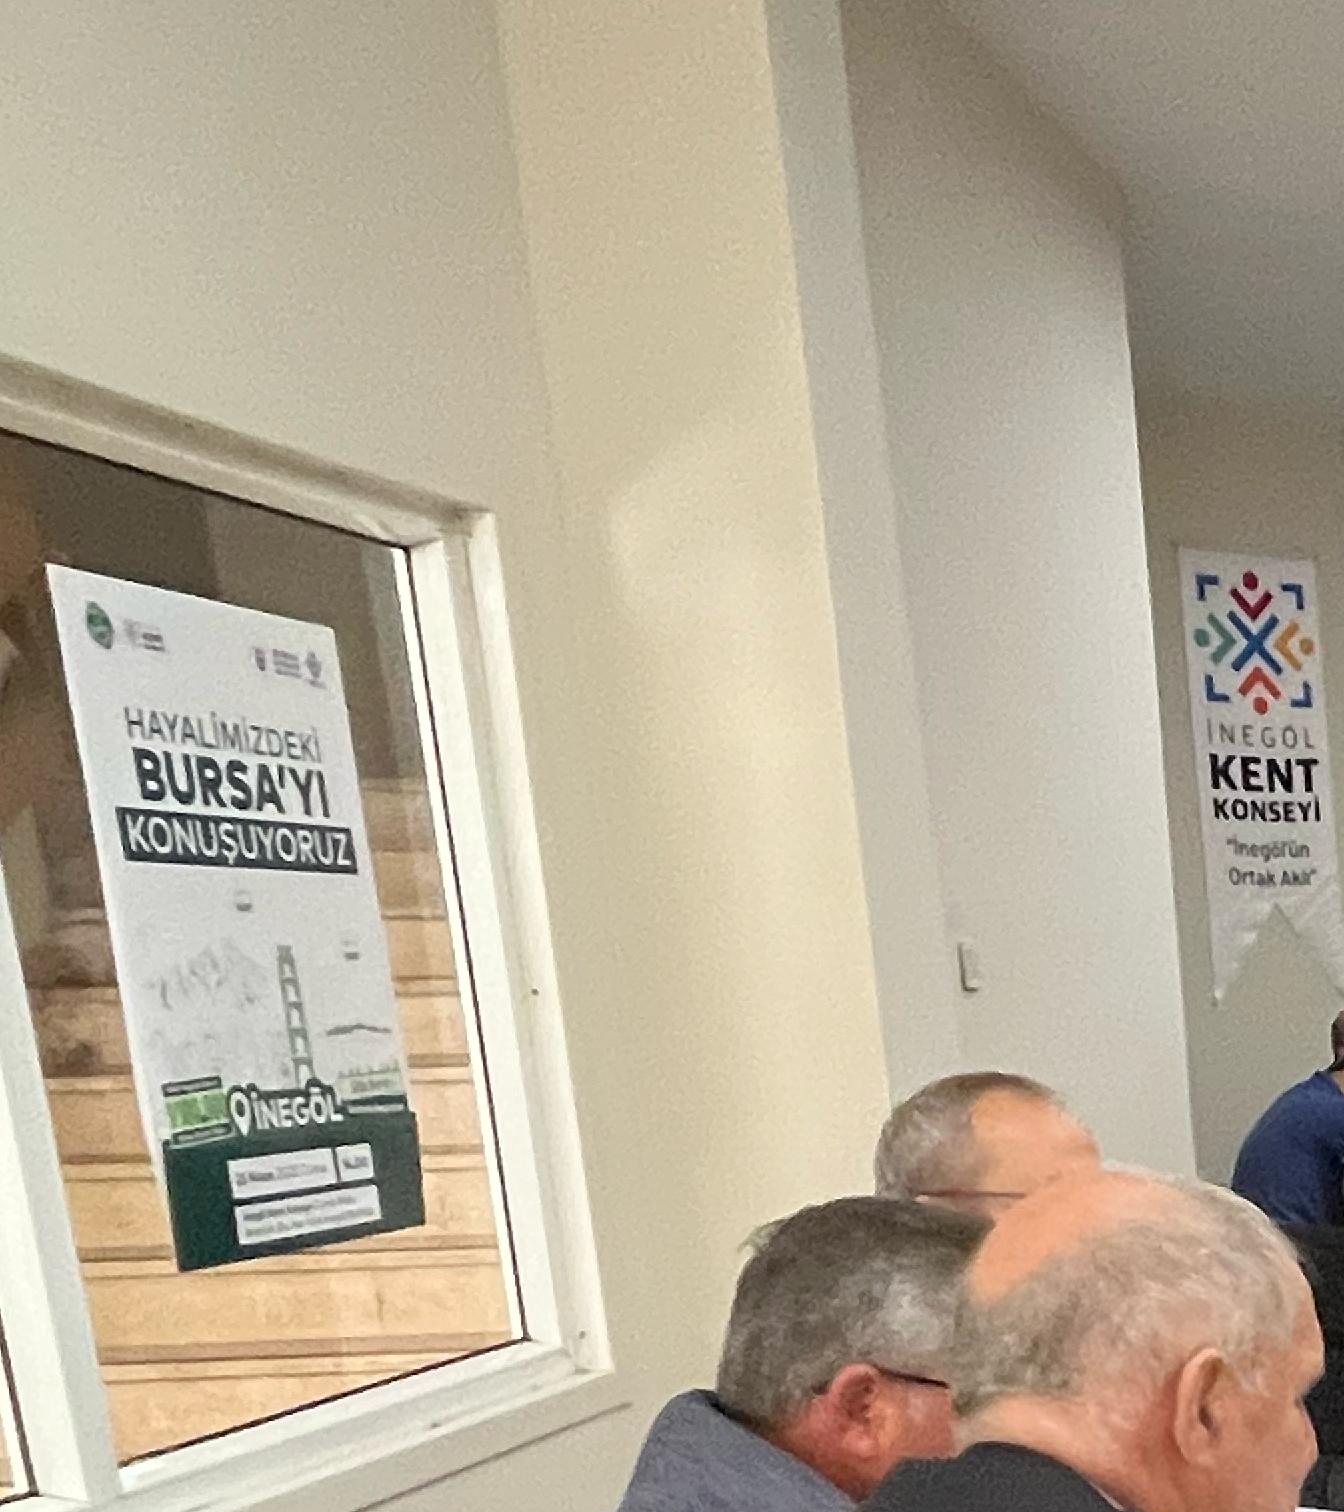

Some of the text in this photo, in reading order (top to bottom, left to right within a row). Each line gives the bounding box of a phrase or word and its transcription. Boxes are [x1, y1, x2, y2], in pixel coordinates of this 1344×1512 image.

[123, 706, 322, 763] HAYALİMİZDEKİ
[132, 747, 330, 818] BURSA'YI
[1208, 752, 1320, 793] KENT
[1212, 795, 1321, 822] KONSEYİ
[125, 813, 352, 866] KONUŞUYORUZ
[1228, 866, 1277, 886] Ortak
[250, 1085, 344, 1130] İNEGÖL
